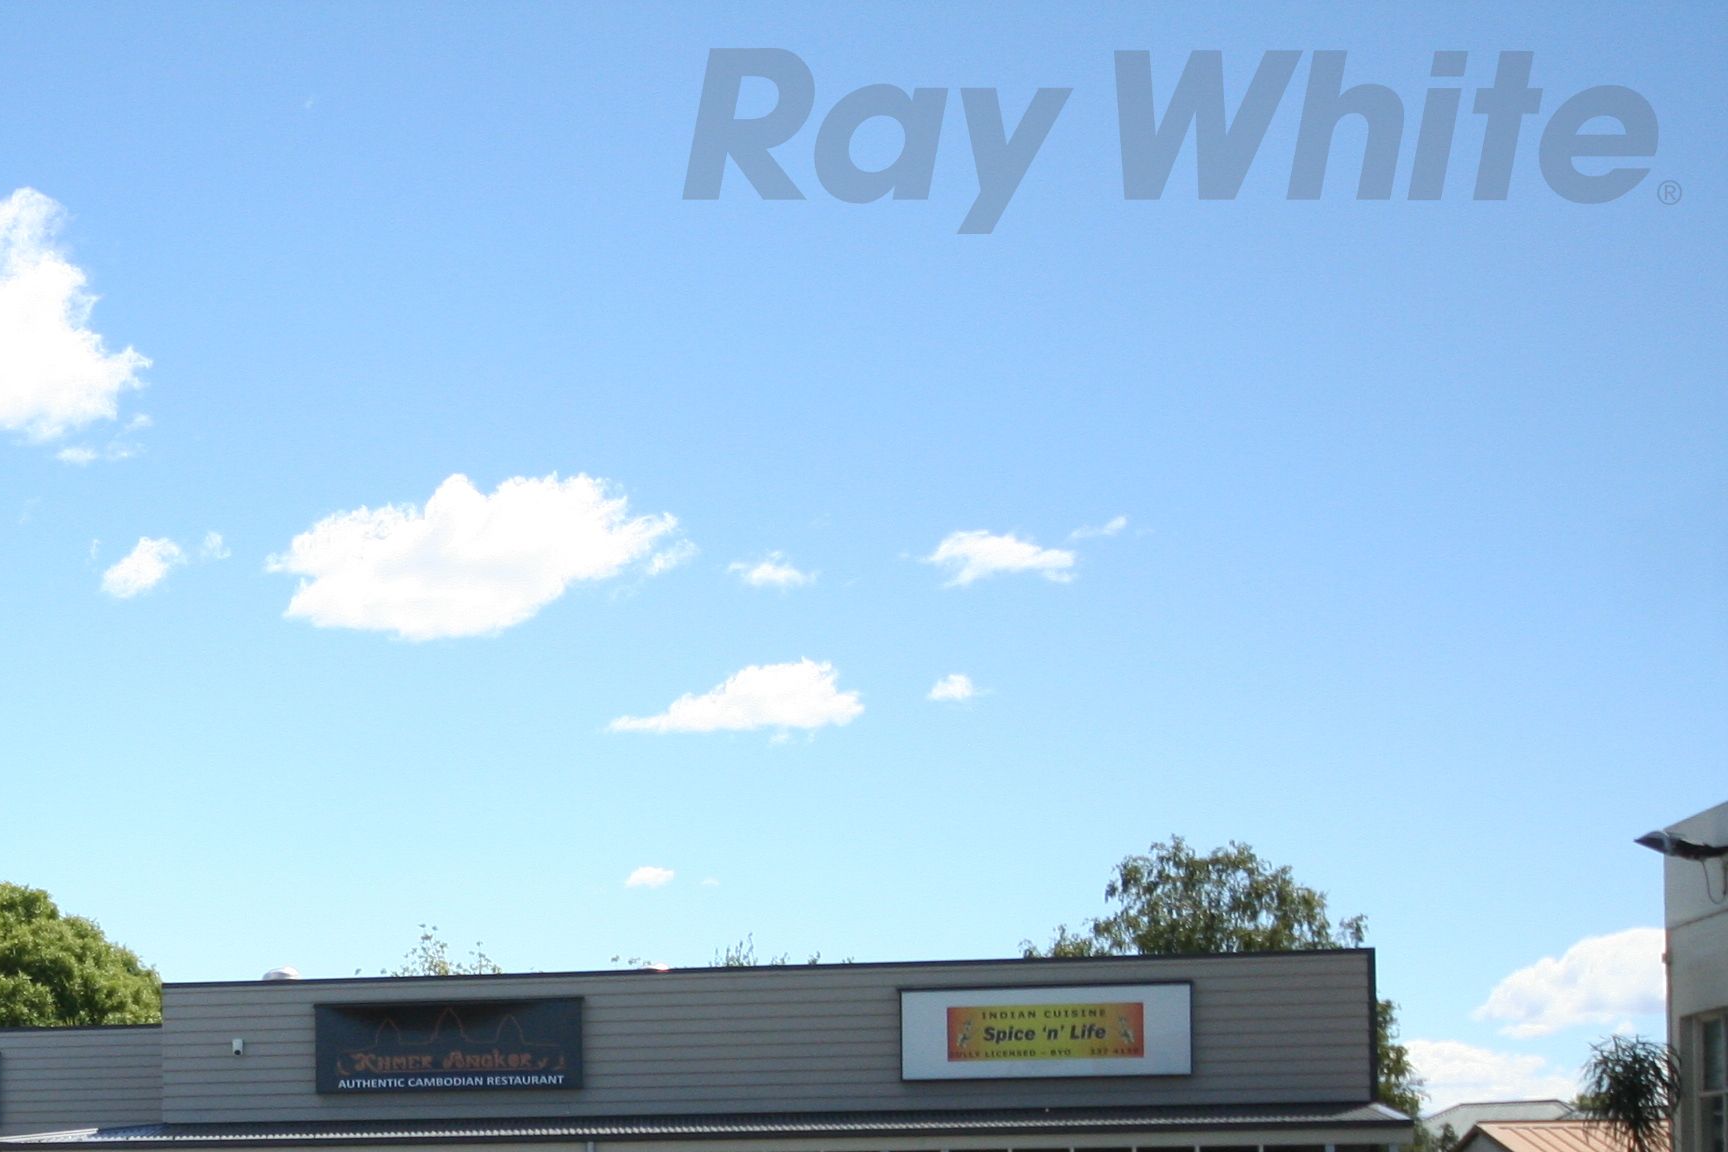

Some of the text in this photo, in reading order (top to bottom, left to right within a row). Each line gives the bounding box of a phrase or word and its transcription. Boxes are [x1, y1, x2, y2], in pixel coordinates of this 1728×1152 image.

[981, 1008, 1107, 1020] INDIAN CUISINE
[983, 1025, 1036, 1044] Spice
[1069, 1023, 1107, 1040] Life
[984, 1049, 1037, 1058] LICENSED
[338, 1075, 566, 1089] AUTHENTIC CAMBODIAN RESTAURANT
